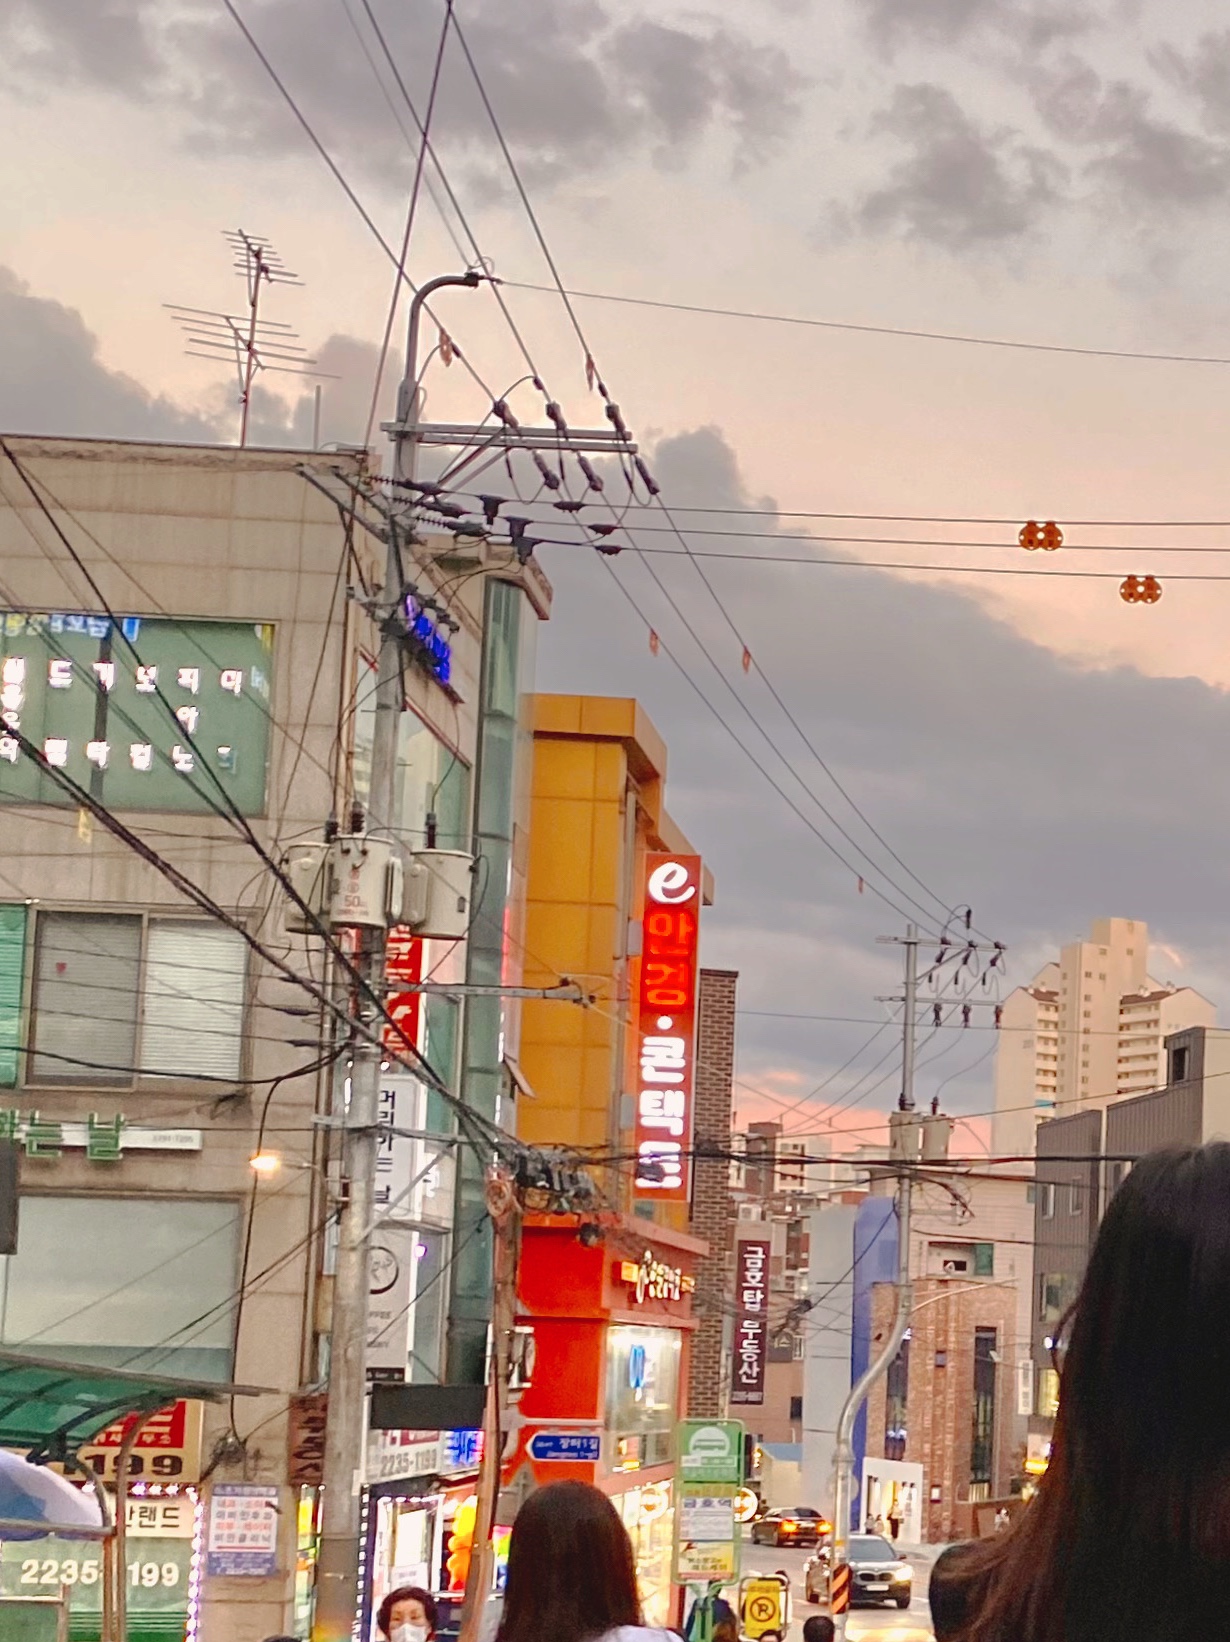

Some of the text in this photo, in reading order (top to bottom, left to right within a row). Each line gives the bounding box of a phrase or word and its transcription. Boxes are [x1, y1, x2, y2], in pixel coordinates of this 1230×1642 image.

[86, 1111, 125, 1160] 날
[741, 1246, 766, 1312] 금호탑
[738, 1319, 761, 1385] 부동산
[20, 1559, 181, 1588] 2235-199
